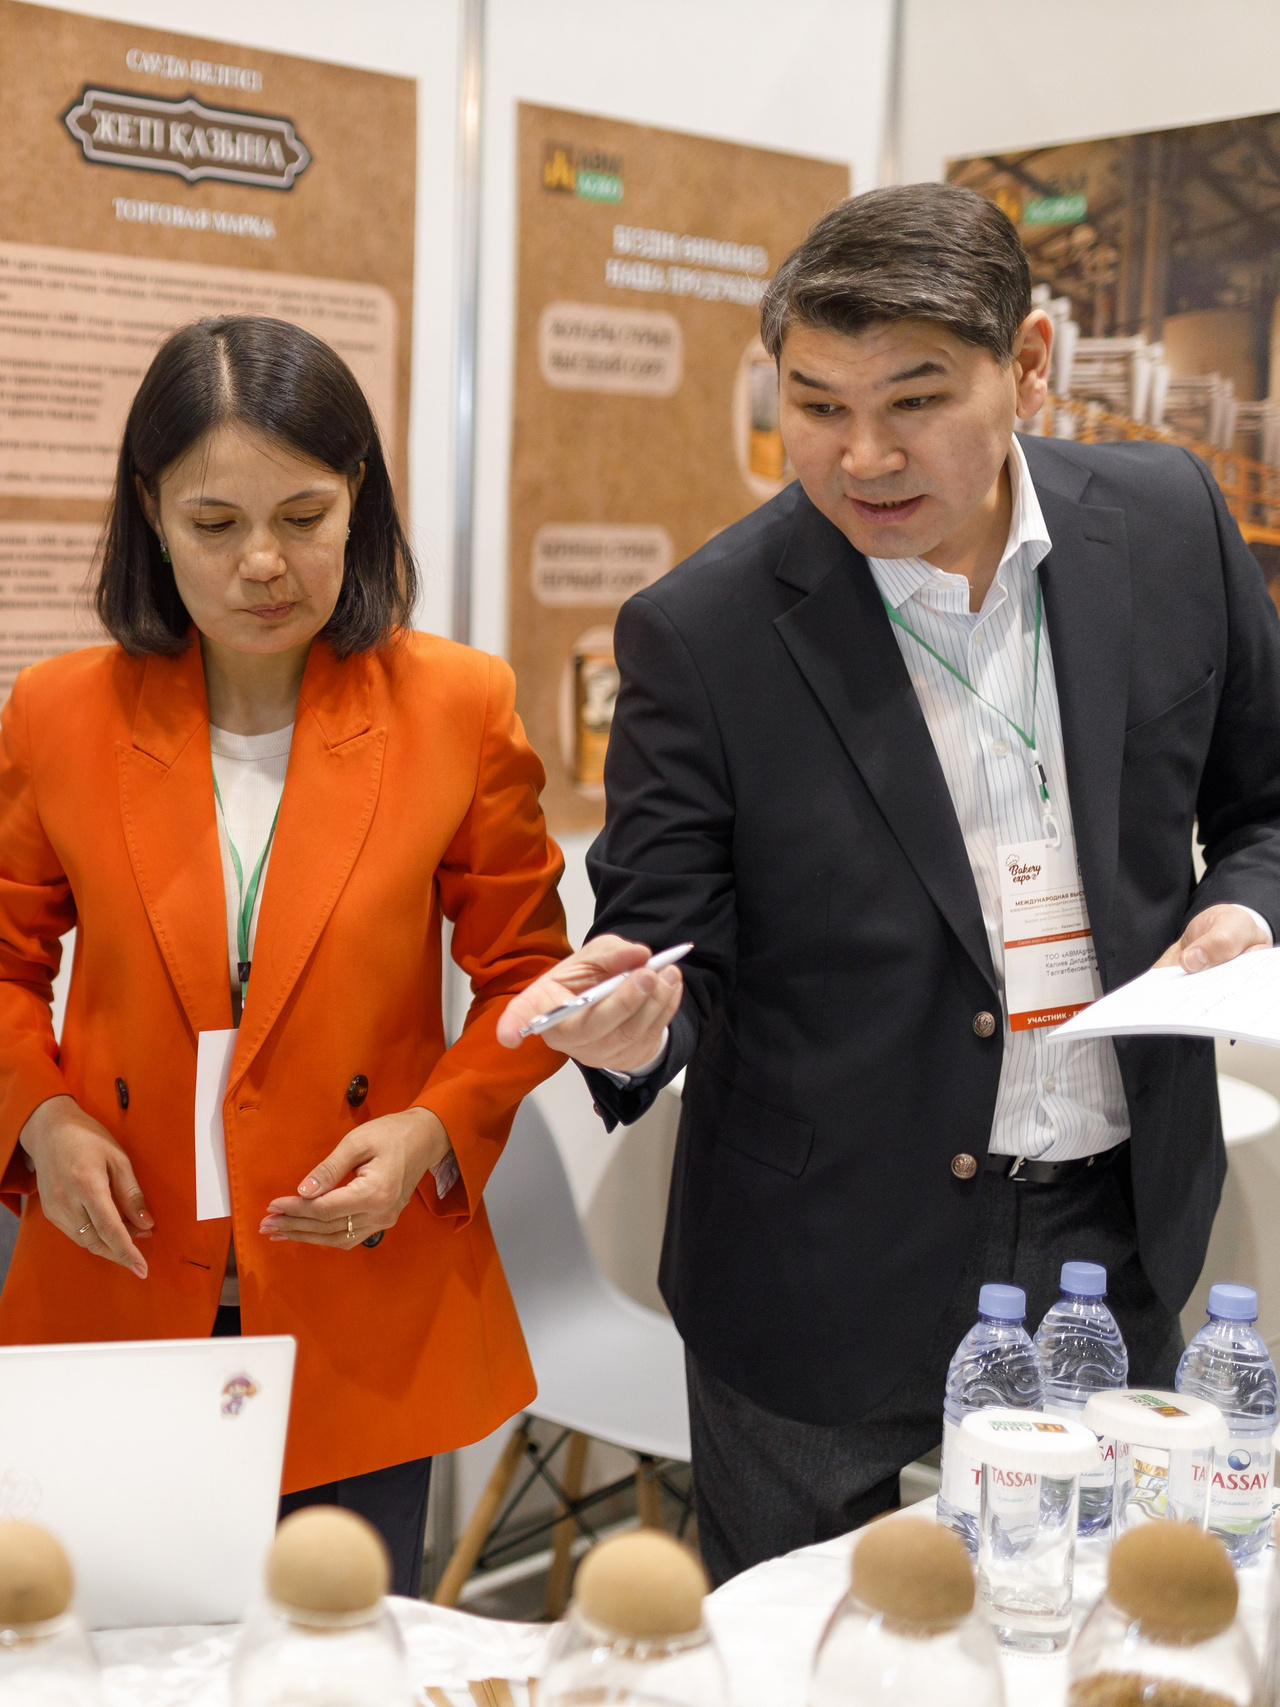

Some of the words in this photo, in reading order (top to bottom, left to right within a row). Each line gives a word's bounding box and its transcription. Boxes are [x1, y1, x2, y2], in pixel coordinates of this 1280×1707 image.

[91, 109, 165, 151] ЖЕТІ
[112, 197, 210, 231] ТОРГОВАЯ
[211, 211, 276, 239] МАРКА
[1009, 863, 1041, 876] Bakery
[1013, 875, 1030, 885] expo
[1015, 894, 1069, 906] МЕЖДУНАРОДНАЯ
[1045, 952, 1060, 961] ТОО
[1046, 960, 1068, 969] Калиев
[1027, 1012, 1067, 1025] УЧАСТНИК
[1211, 1471, 1269, 1491] ASSAY
